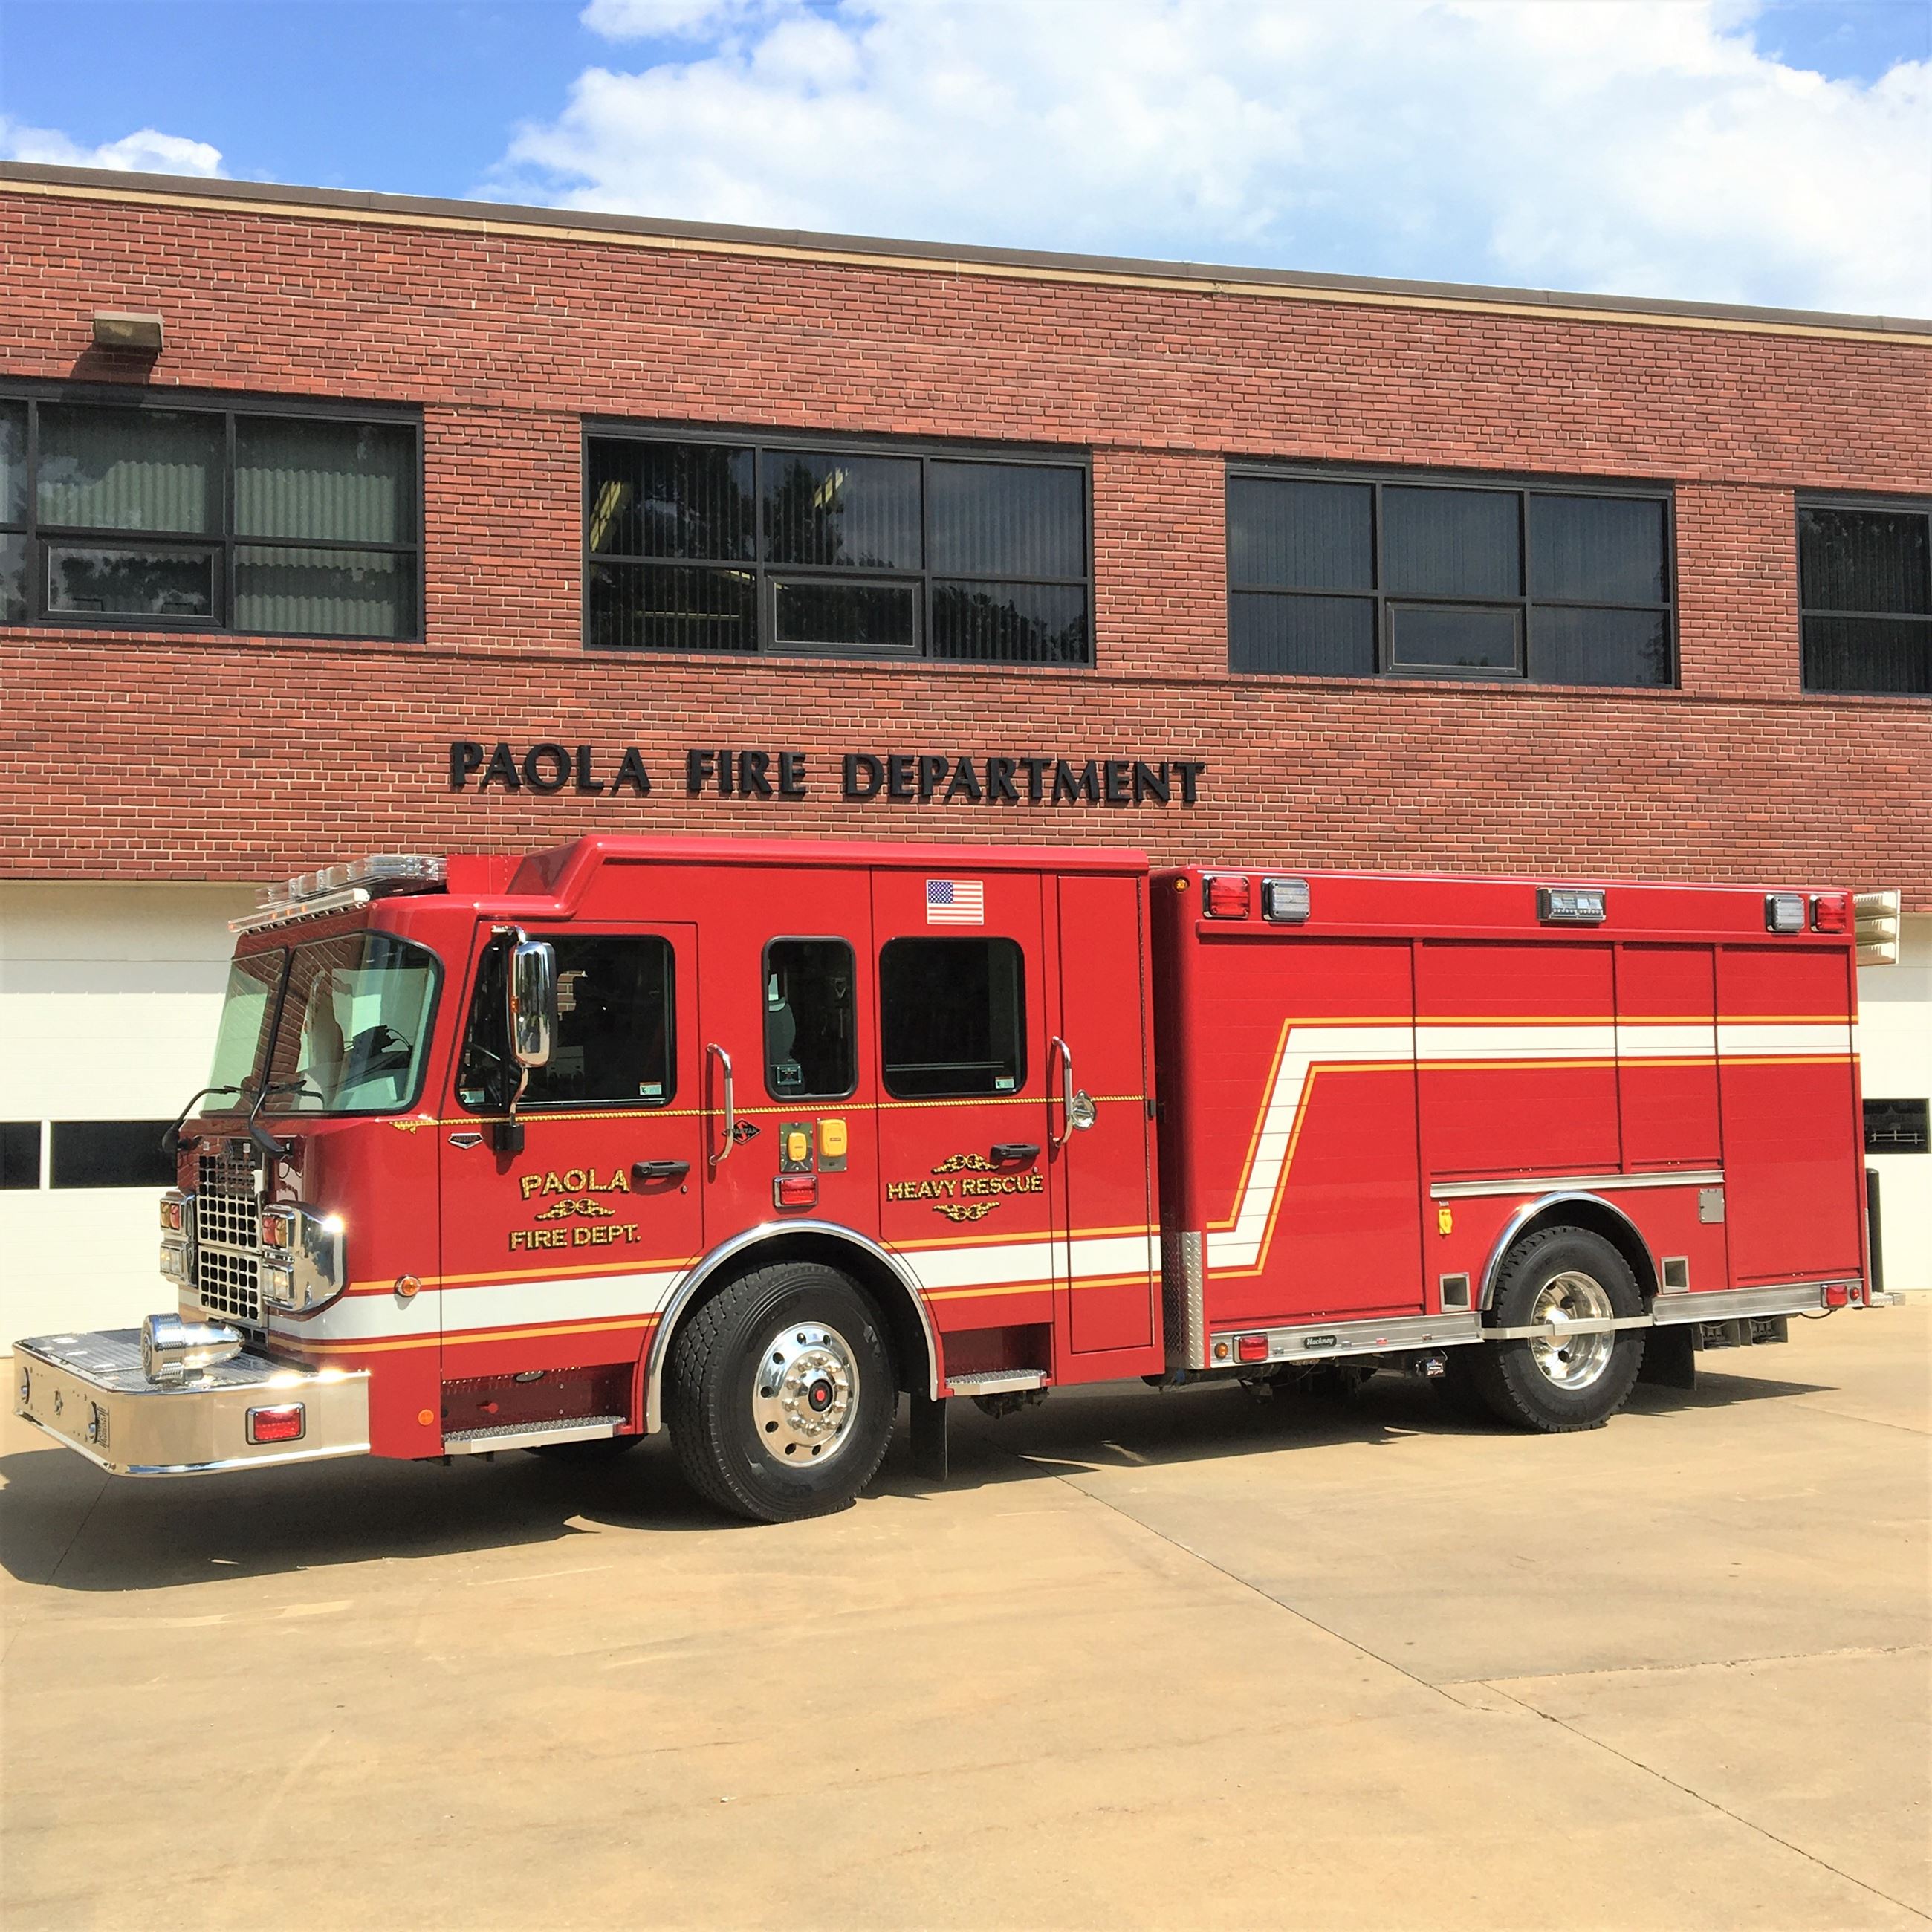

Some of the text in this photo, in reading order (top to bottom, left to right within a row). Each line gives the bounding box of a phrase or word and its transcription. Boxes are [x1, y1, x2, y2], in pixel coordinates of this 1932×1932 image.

[450, 741, 1205, 802] PAOLA FIRE DEPARTMENT
[520, 1168, 631, 1199] PAOLA
[887, 1174, 1044, 1200] HEAVY RESCUE
[510, 1223, 642, 1251] FIRE DEPT.
